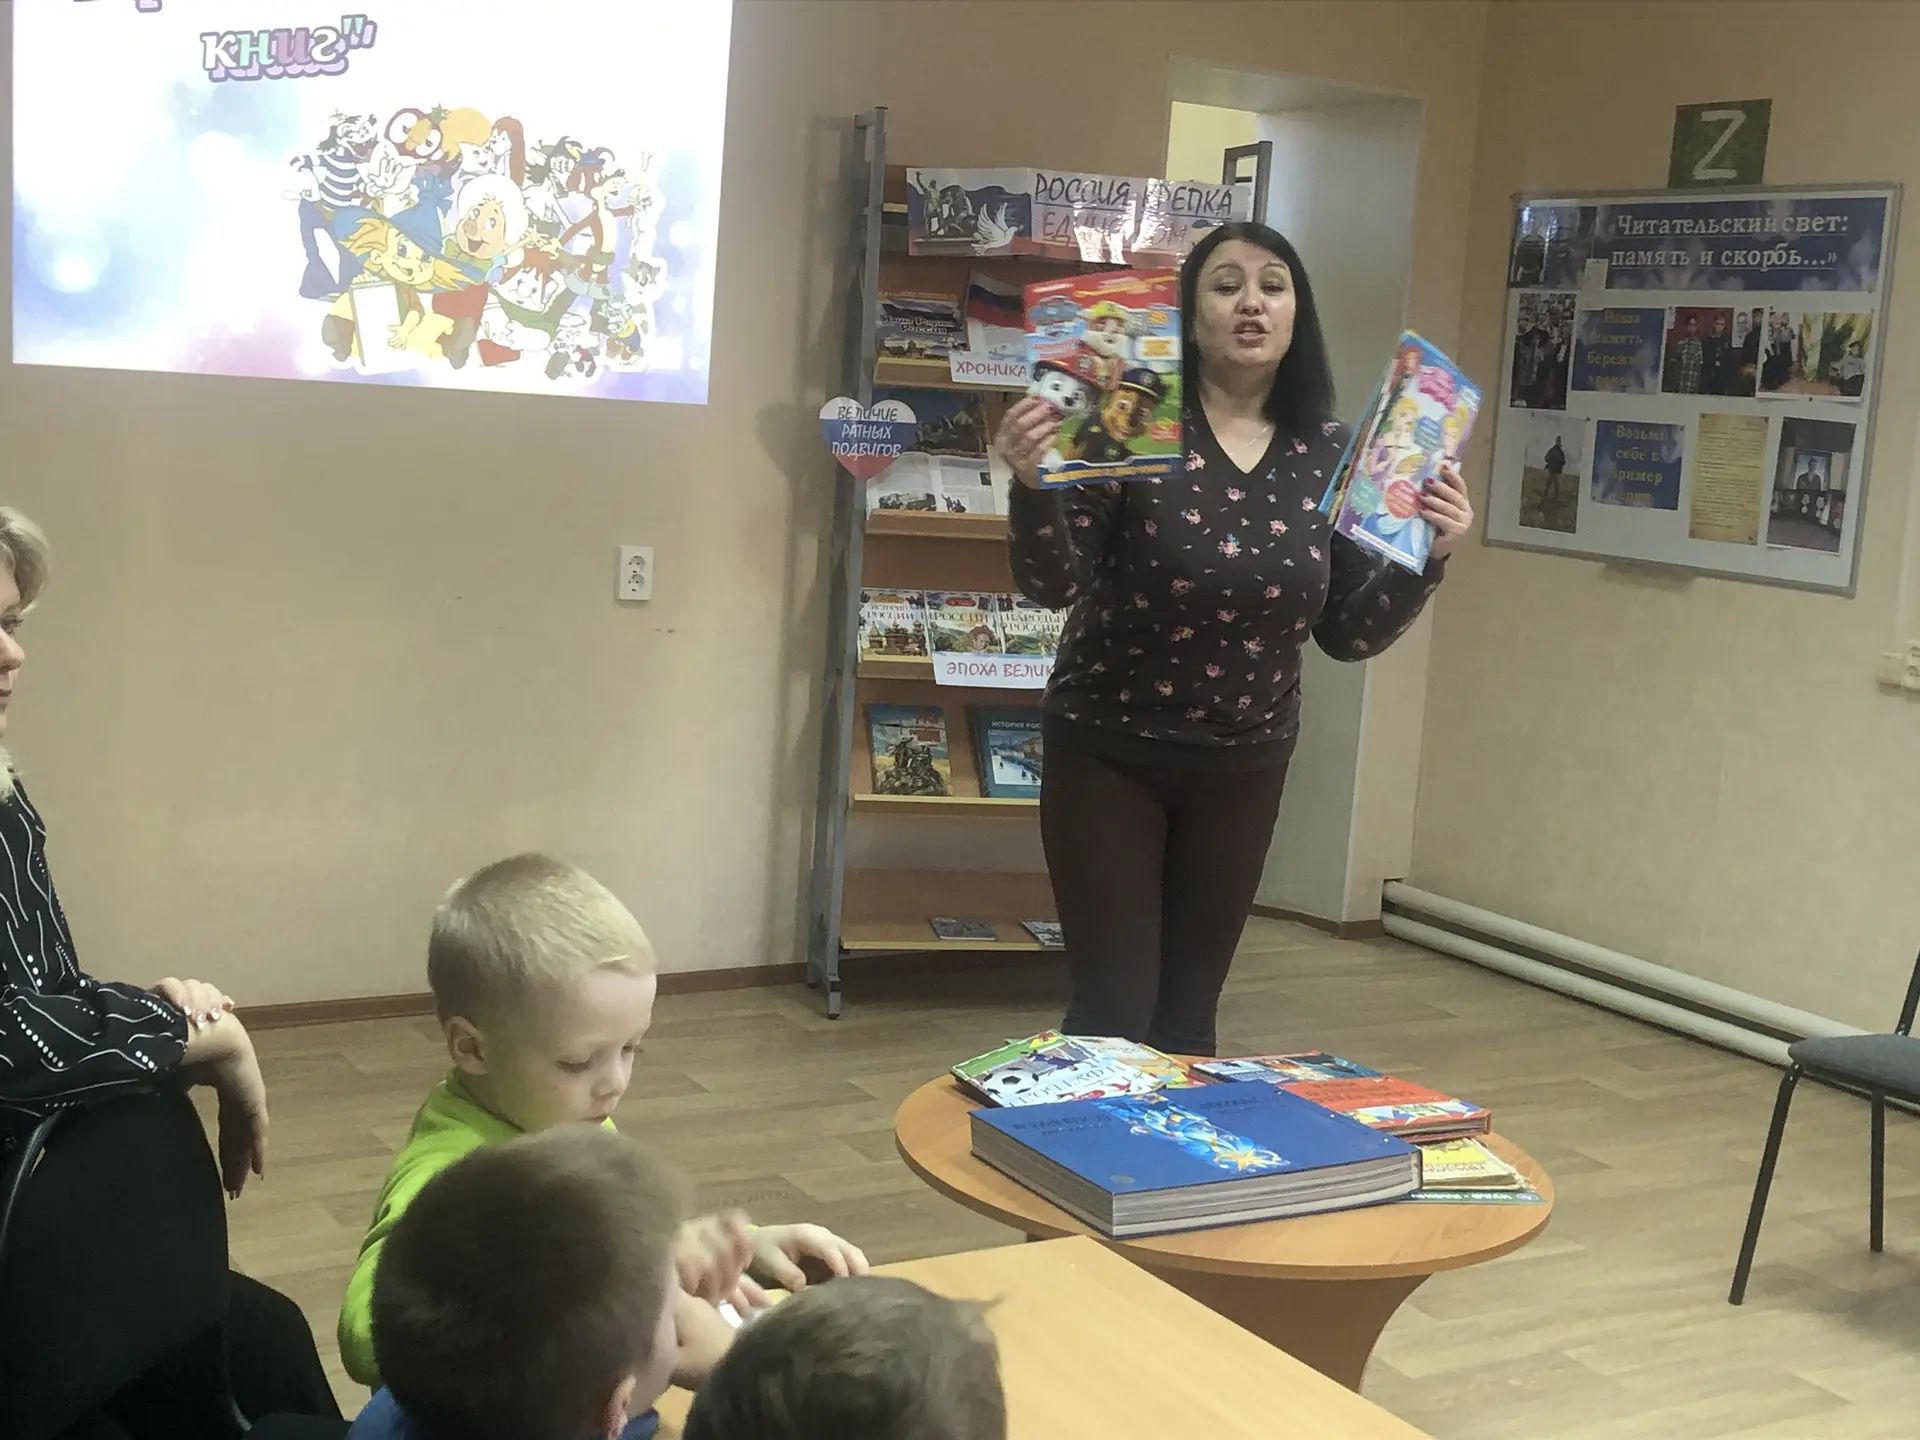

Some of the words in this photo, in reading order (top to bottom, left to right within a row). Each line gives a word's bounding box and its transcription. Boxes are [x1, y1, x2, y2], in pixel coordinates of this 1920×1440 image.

[1692, 109, 1746, 181] Z
[1035, 172, 1132, 206] РОССИЯ
[1783, 214, 1848, 233] свет:
[1611, 250, 1690, 266] память
[1700, 250, 1713, 266] и
[956, 360, 1027, 378] ХРОНИКА
[837, 405, 898, 421] ВЕЛИЧИЕ
[841, 423, 892, 439] РАТНЫХ
[831, 441, 902, 458] ПОДВИГОВ
[946, 661, 998, 677] ЭПОХА
